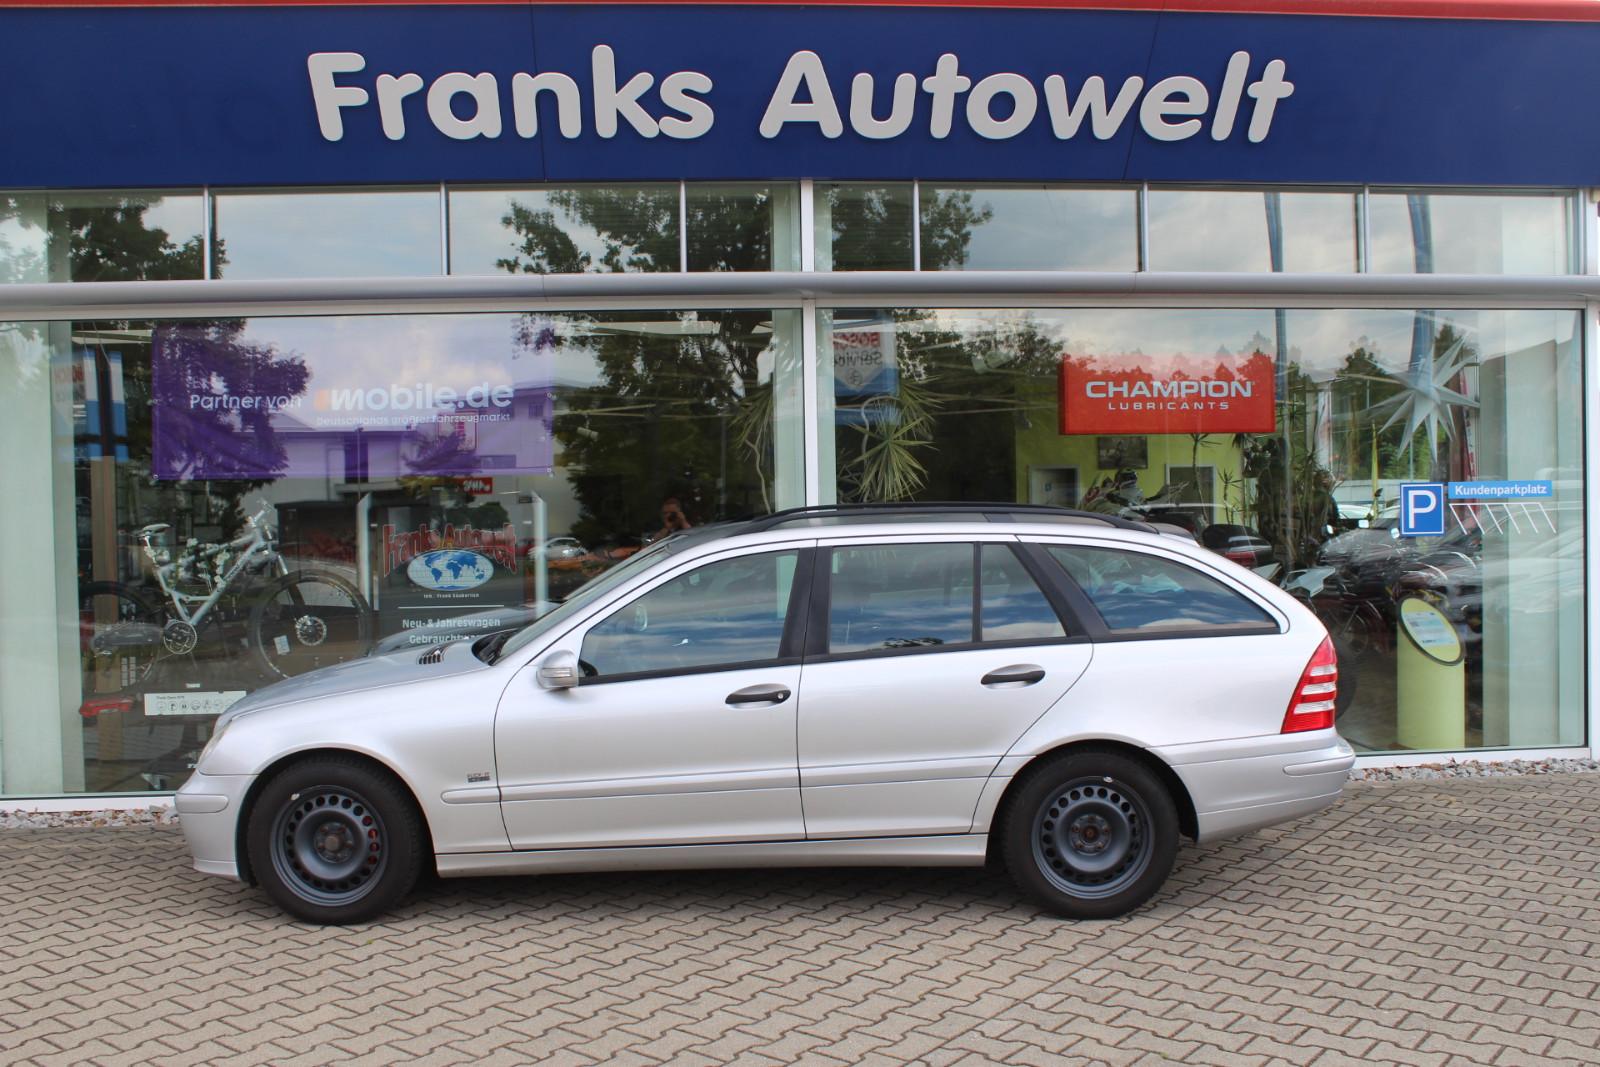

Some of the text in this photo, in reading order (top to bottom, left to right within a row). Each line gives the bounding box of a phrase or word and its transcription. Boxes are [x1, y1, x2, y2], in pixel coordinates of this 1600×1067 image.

[307, 44, 1295, 143] Franks Autowelt
[331, 382, 514, 410] mobile.de
[1085, 381, 1252, 398] CHAMPION
[190, 394, 302, 410] Partner von
[1108, 401, 1230, 410] LUBRICANTS
[433, 413, 511, 424] Fahrzeugmarkt
[1455, 484, 1547, 497] Kundenparkplatz
[1408, 489, 1437, 529] P
[402, 617, 501, 628] Neu- & Jahreswagen
